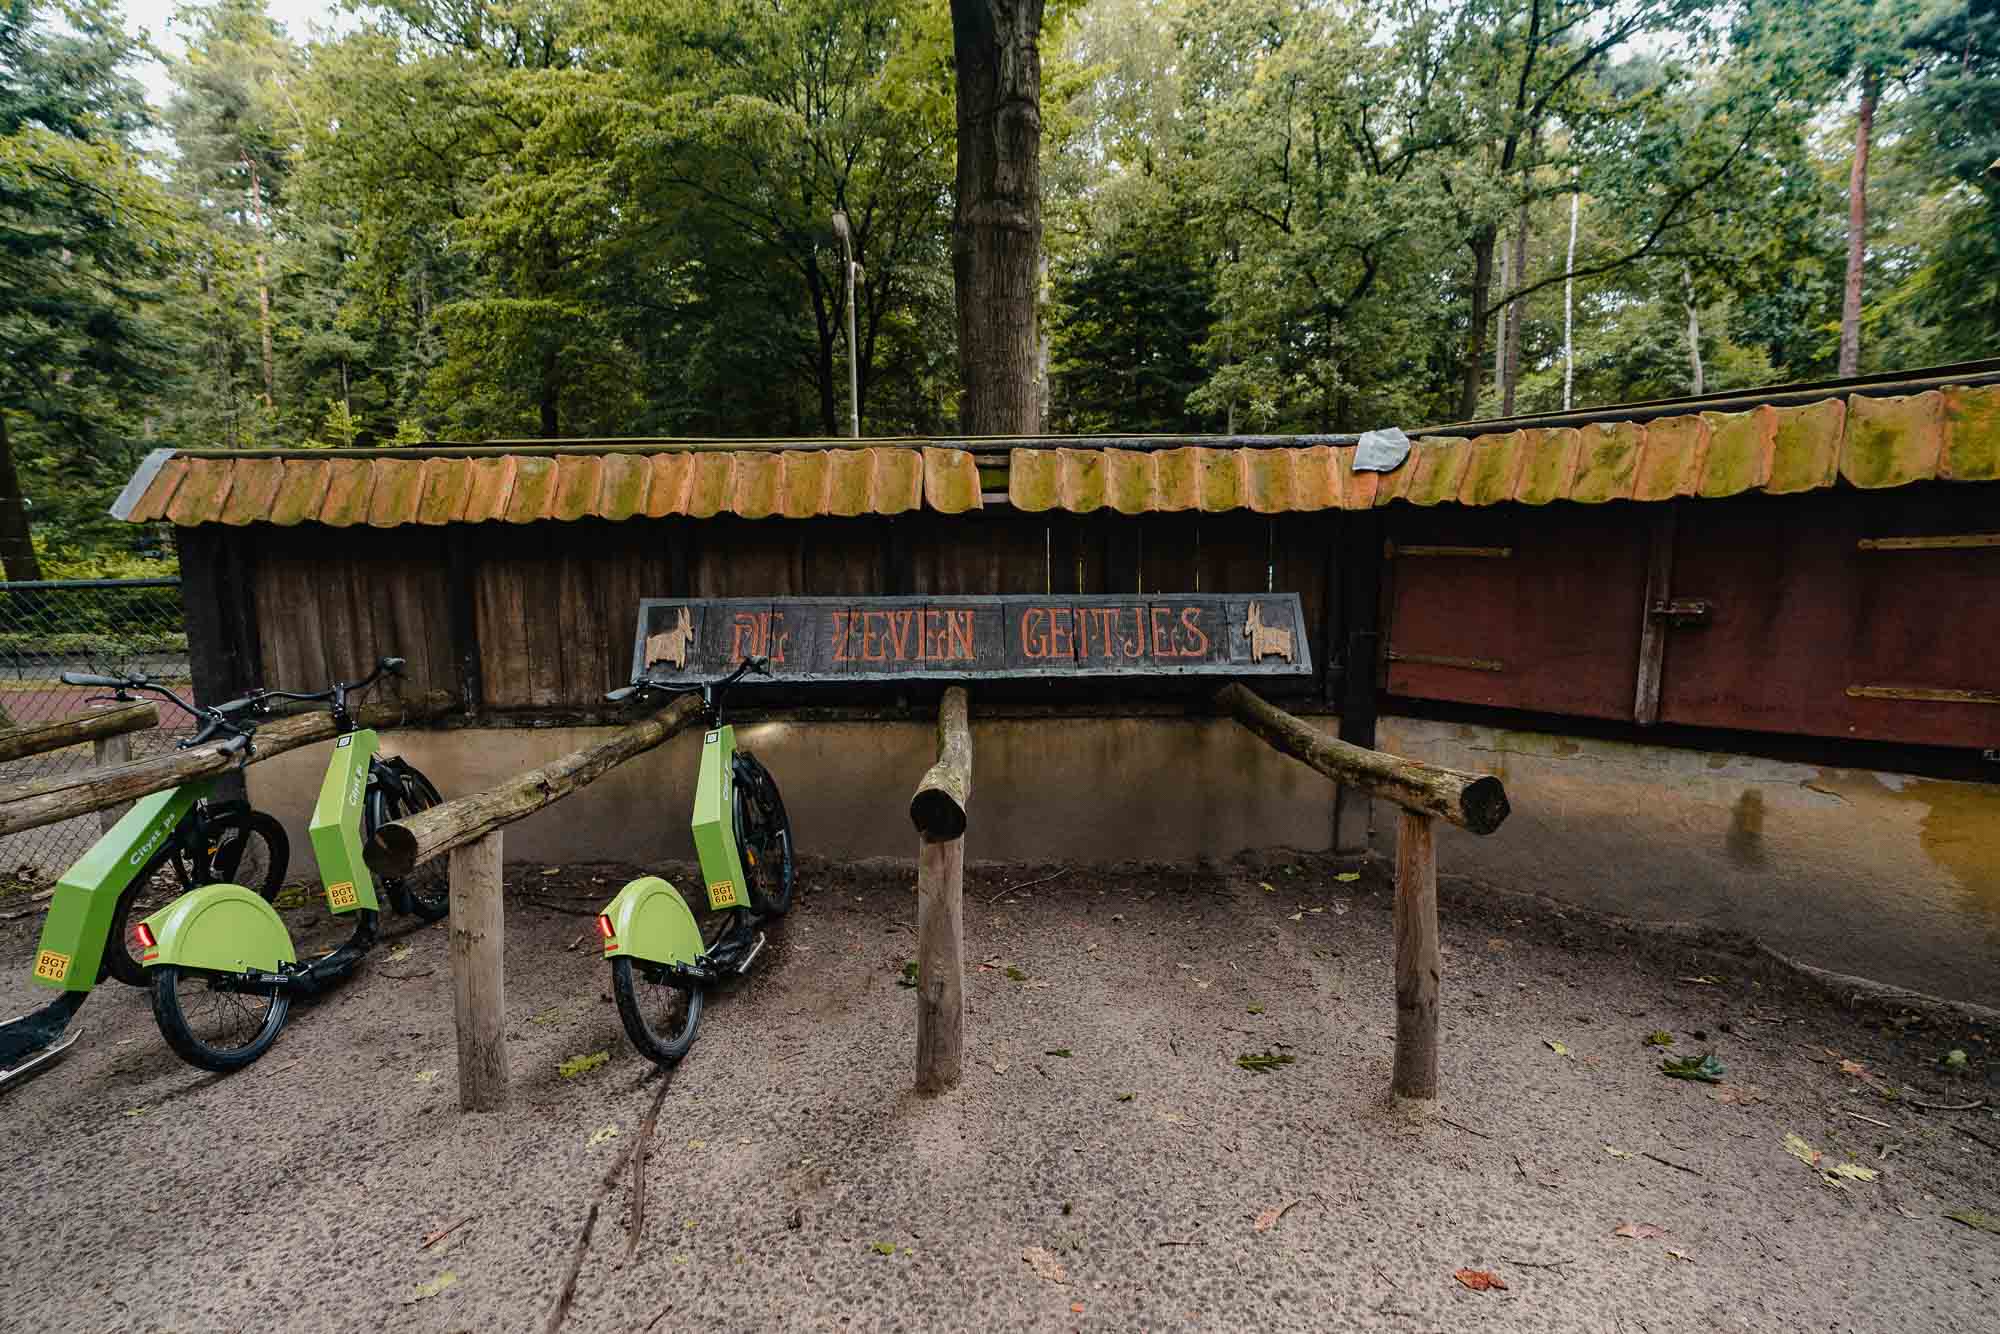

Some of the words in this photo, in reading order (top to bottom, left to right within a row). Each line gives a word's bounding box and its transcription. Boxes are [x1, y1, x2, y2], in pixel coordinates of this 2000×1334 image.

[832, 608, 977, 662] ZEVEN
[1022, 607, 1209, 658] GEITJES
[331, 886, 353, 898] BGT
[712, 885, 732, 896] BGT
[334, 894, 356, 906] 662
[715, 893, 734, 904] 604
[41, 955, 67, 969] BGT
[38, 965, 64, 979] 610
